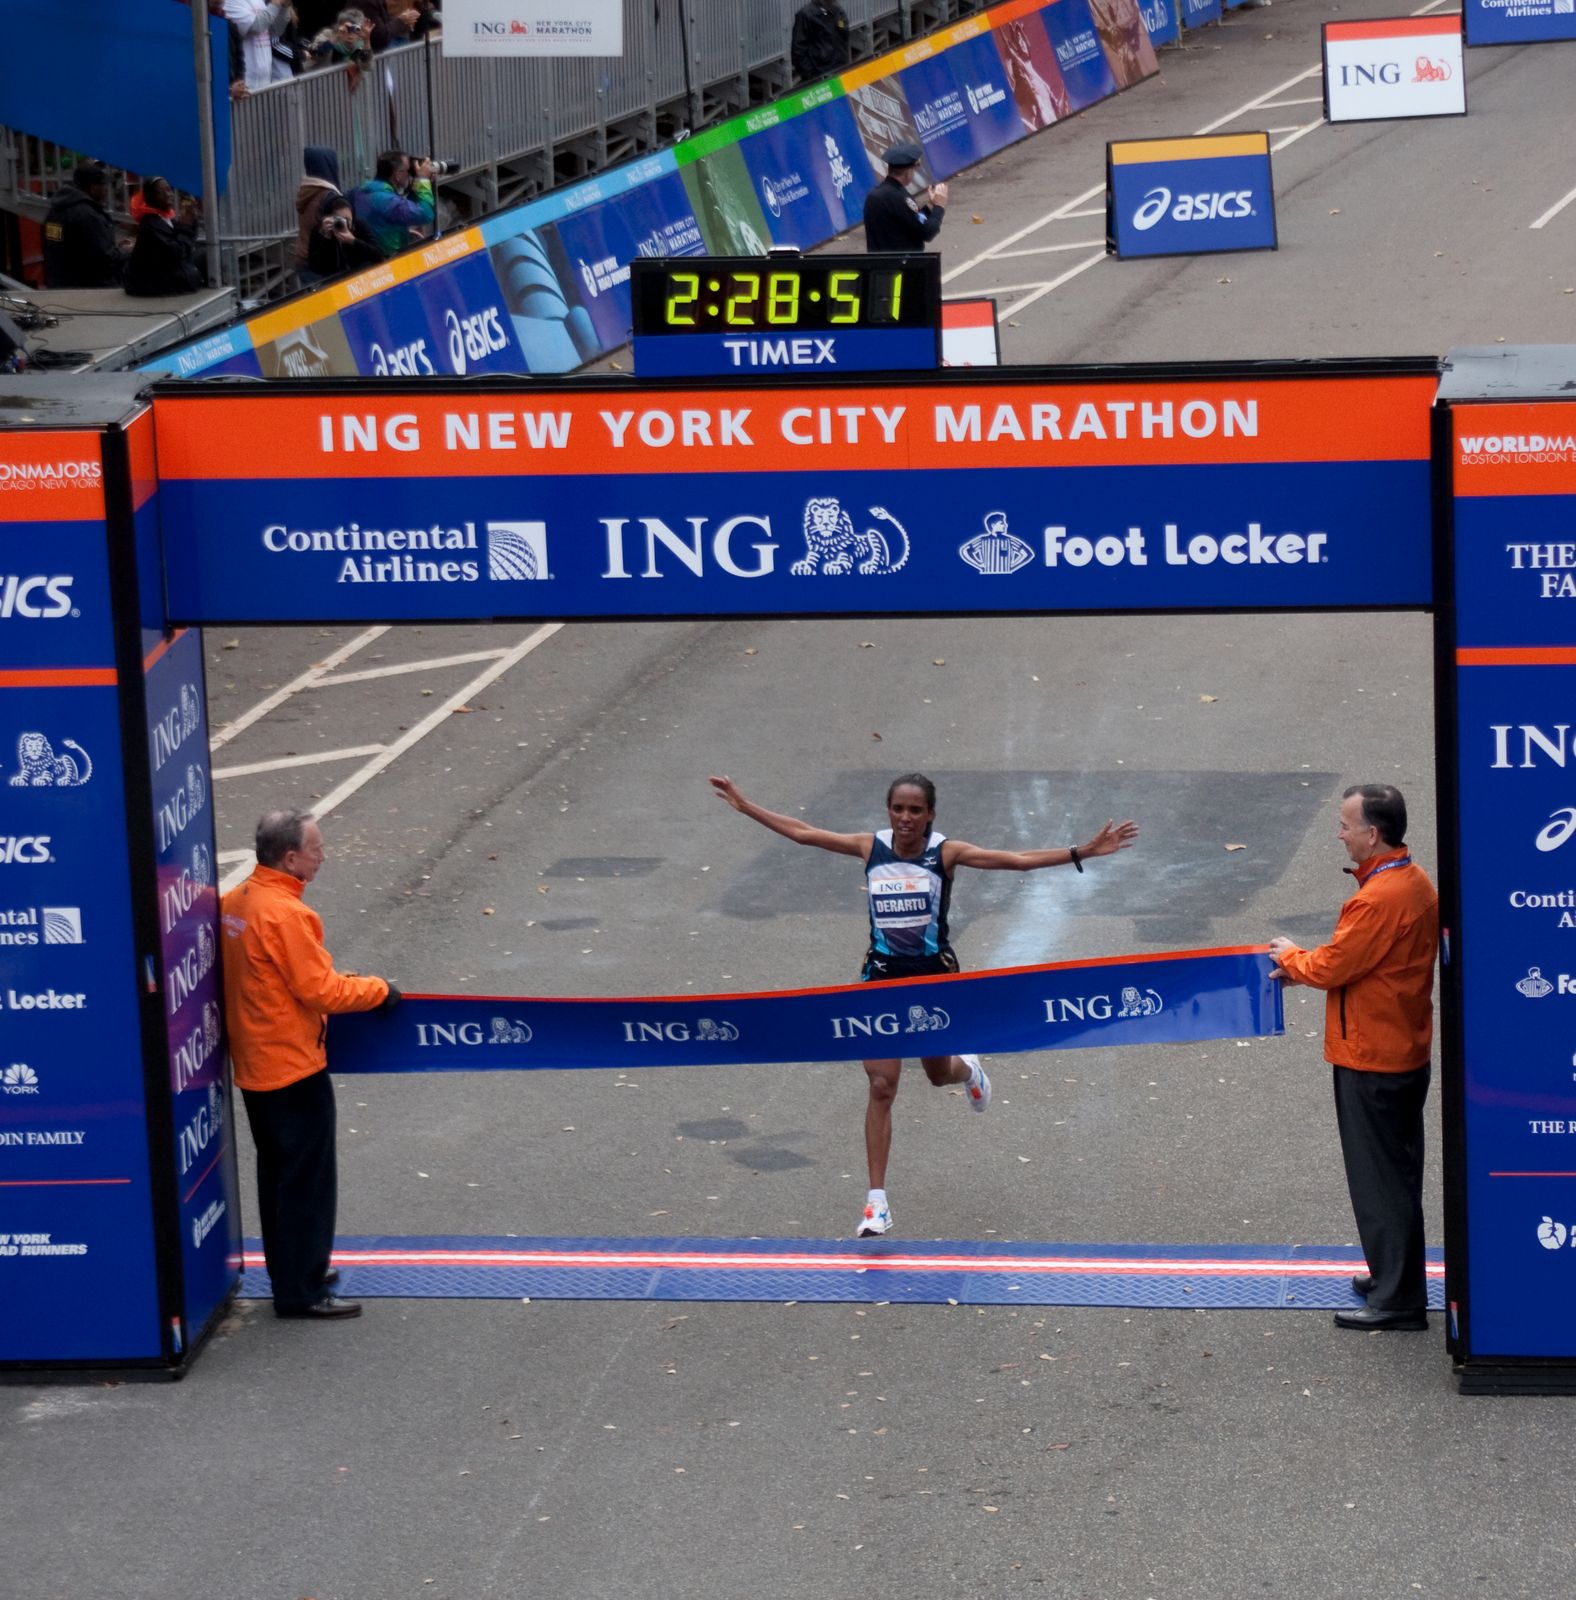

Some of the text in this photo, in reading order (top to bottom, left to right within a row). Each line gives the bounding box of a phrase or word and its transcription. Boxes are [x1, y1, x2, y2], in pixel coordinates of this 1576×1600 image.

[1506, 6, 1552, 17] Airlines
[474, 22, 505, 34] ING
[536, 27, 592, 35] MARATHON
[1056, 45, 1070, 63] ING
[1341, 63, 1402, 87] ING
[913, 111, 931, 134] ING
[937, 101, 964, 122] MARATHON
[1172, 190, 1252, 222] asics
[664, 215, 696, 237] NEW YORK CITY
[638, 239, 660, 257] ING
[669, 227, 702, 251] MARATHON
[461, 307, 508, 361] asics
[178, 352, 197, 375] ING
[723, 339, 836, 366] TIMEX
[320, 400, 1259, 452] ING NEW YORK CITY MARATHON
[1461, 453, 1511, 465] BOSTON
[1515, 452, 1567, 464] LONDON
[41, 479, 68, 490] NEW
[72, 478, 101, 489] YORK
[263, 522, 479, 553] Continental
[599, 515, 778, 579] ING
[1044, 523, 1327, 567] Foot Locker
[1506, 544, 1576, 569] THE
[337, 557, 480, 583] Airlines
[0, 576, 74, 618] ICS
[152, 707, 182, 771] ING
[1490, 725, 1576, 768] IN
[159, 788, 188, 853] ING
[880, 883, 902, 892] ING
[163, 868, 193, 934] ING
[875, 898, 927, 913] DERARTU
[169, 947, 198, 1014] ING
[9, 989, 86, 1010] Locker
[1043, 995, 1113, 1023] ING
[416, 1021, 691, 1046] ING ING
[830, 1013, 900, 1039] ING
[174, 1027, 203, 1095] ING
[3, 1086, 40, 1095] YORK
[27, 1131, 86, 1145] FAMILY
[1529, 1121, 1566, 1134] THE
[180, 1105, 209, 1175] ING
[12, 1234, 51, 1244] YORK
[21, 1244, 88, 1255] RUNNERS
